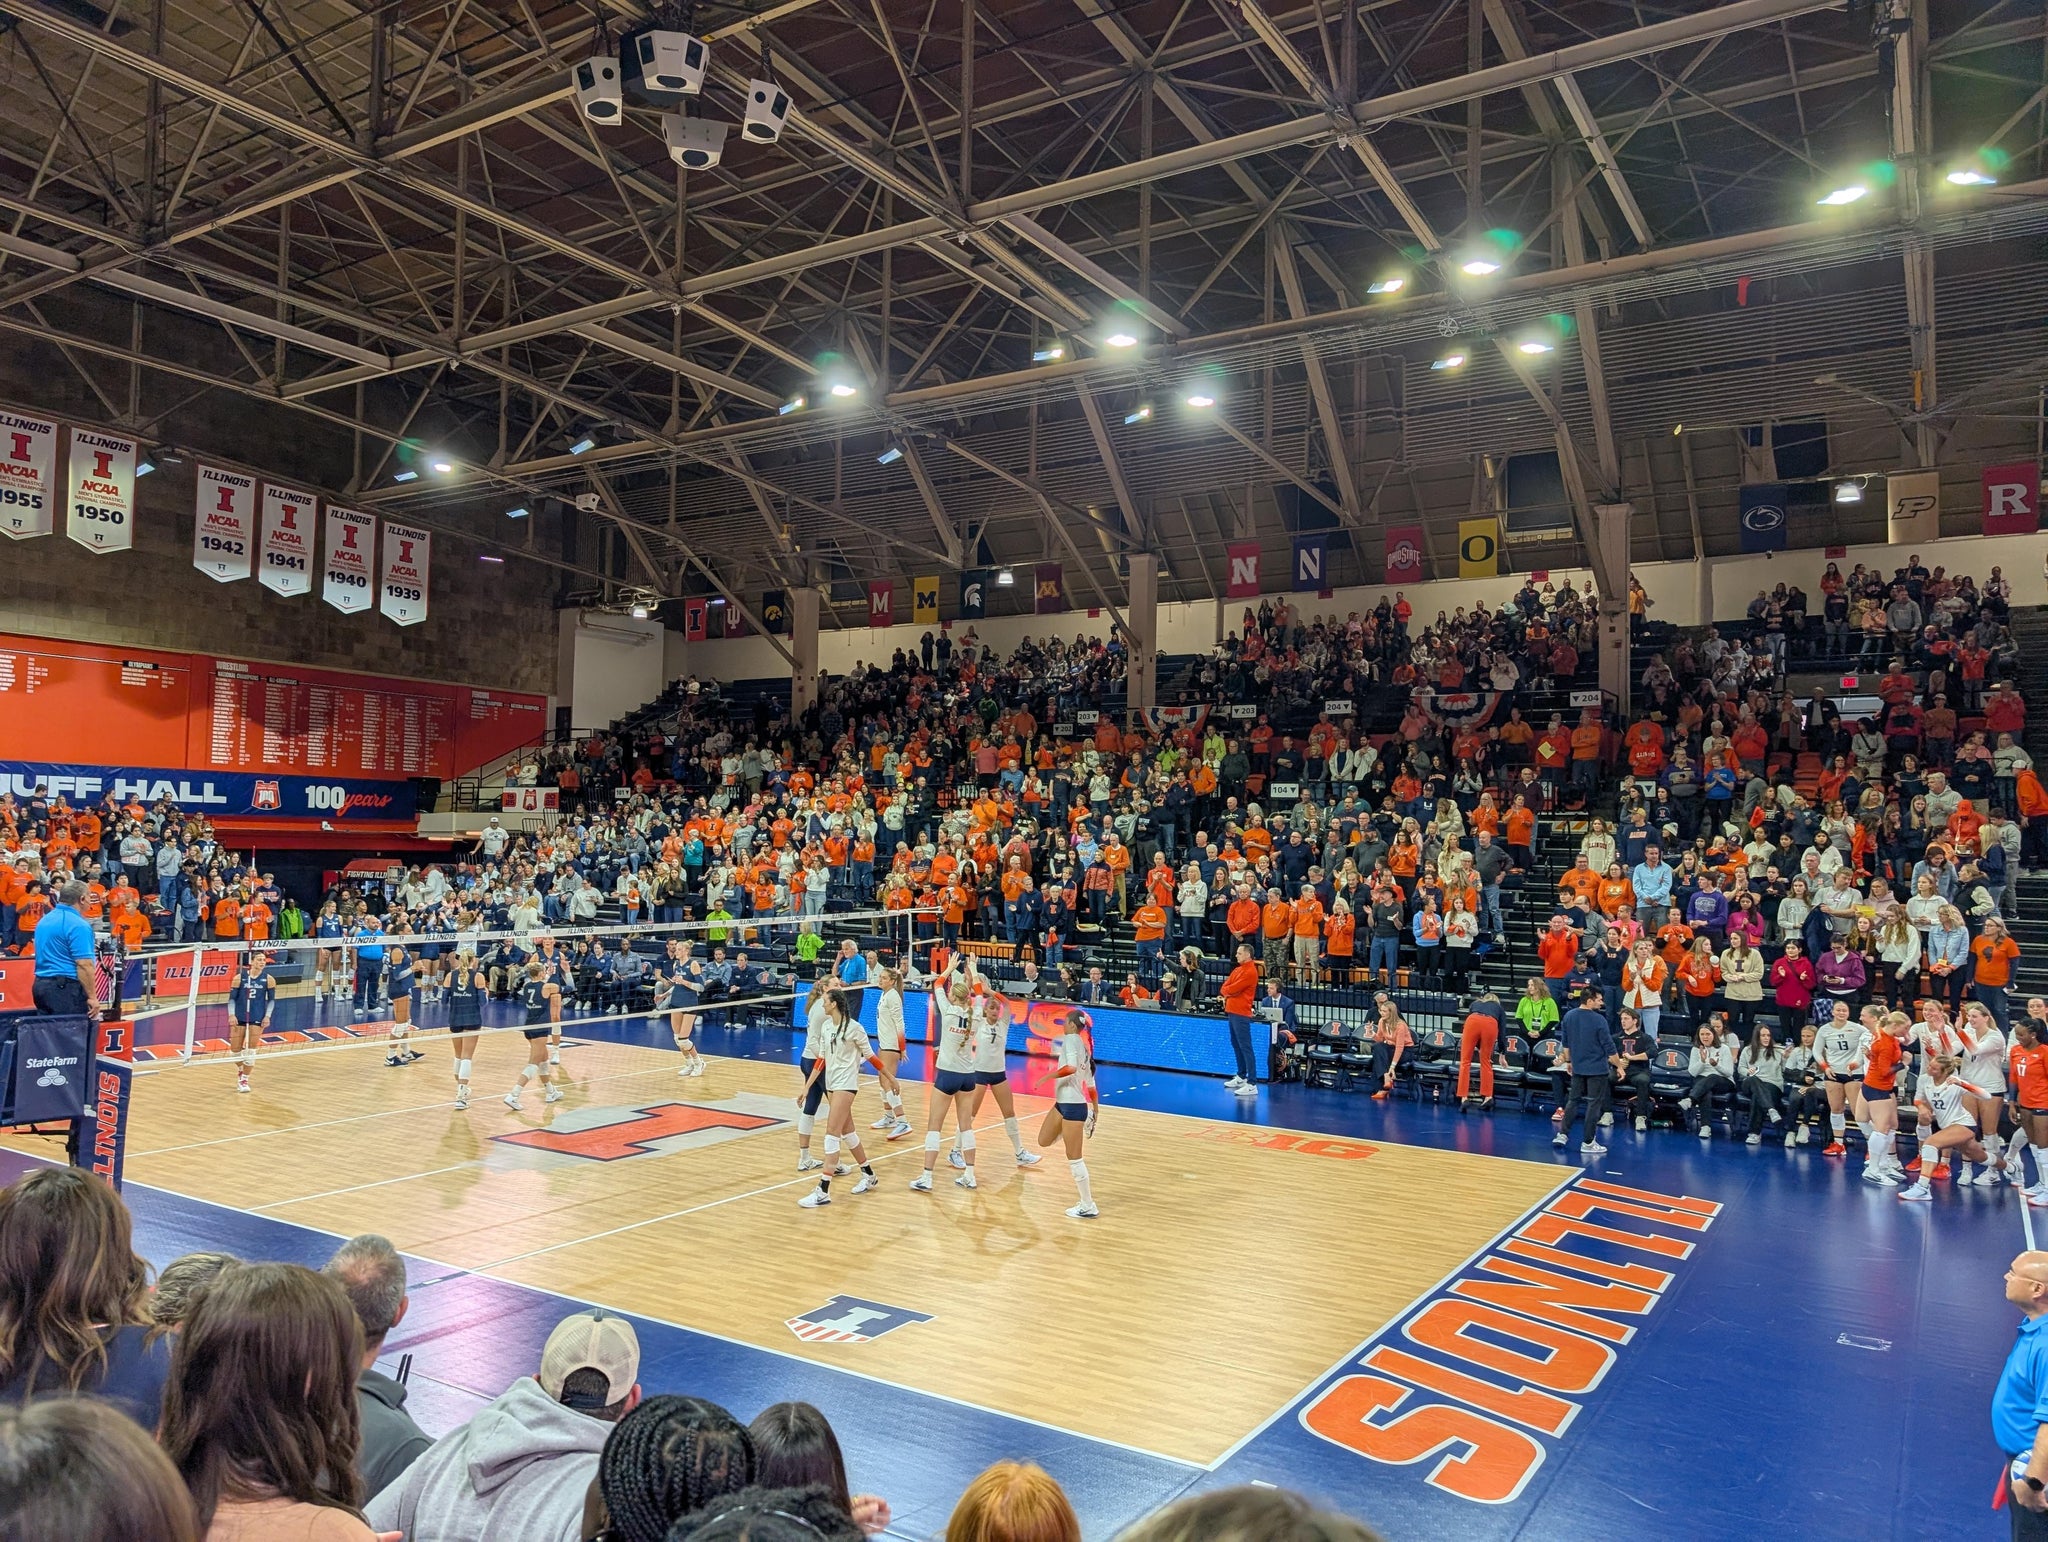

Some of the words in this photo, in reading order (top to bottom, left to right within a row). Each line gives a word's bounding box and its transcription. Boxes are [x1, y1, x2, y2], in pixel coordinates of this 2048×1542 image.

[0, 416, 51, 434] LLINOIS
[10, 432, 31, 462] I
[77, 434, 131, 452] ILLINOIS
[0, 462, 38, 480] NCAA
[93, 450, 113, 479] I
[203, 470, 250, 488] ILLINOIS
[82, 480, 118, 496] NCAA
[217, 486, 234, 512] I
[268, 489, 312, 505] ILLINOIS
[1988, 483, 2031, 516] R
[75, 504, 124, 524] 1950
[1891, 496, 1936, 520] P
[207, 514, 240, 528] NCAA
[281, 504, 297, 530] I
[331, 510, 372, 526] ILLINOIS
[272, 530, 302, 544] NCAA
[343, 524, 358, 548] I
[388, 526, 426, 540] ILLINOIS
[201, 536, 244, 555] 1942
[399, 540, 414, 563] I
[1462, 536, 1494, 562] O
[267, 552, 304, 570] 1941
[334, 550, 362, 564] NCAA
[1300, 548, 1320, 580] N
[391, 565, 417, 577] NCAA
[1232, 557, 1257, 584] N
[328, 571, 366, 588] 1940
[387, 585, 420, 600] 1939
[1036, 582, 1059, 599] M
[872, 591, 889, 614] M
[917, 591, 936, 608] M
[688, 608, 702, 632] I
[1582, 694, 1599, 702] 204
[114, 778, 227, 804] HALL
[305, 785, 345, 809] 100
[336, 793, 392, 816] years
[425, 933, 456, 941] ILLINOIS
[500, 930, 528, 938] ILLINOIS
[568, 926, 594, 934] ILLINOIS
[251, 940, 288, 948] LLINOIS
[342, 936, 377, 944] ILLINOIS
[1735, 960, 1744, 972] I
[249, 989, 256, 998] 2
[528, 989, 536, 1004] 7
[1331, 1022, 1341, 1036] I
[104, 1028, 124, 1052] I
[990, 1032, 996, 1044] 7
[1434, 1030, 1444, 1046] I
[1508, 1038, 1518, 1052] I
[1837, 1040, 1848, 1051] 13
[1546, 1042, 1556, 1056] I
[1622, 1039, 1636, 1055] I
[1666, 1052, 1678, 1066] I
[2016, 1064, 2026, 1077] 17
[1932, 1099, 1946, 1111] 22
[93, 1070, 121, 1190] LLINOIS
[489, 1103, 790, 1162] I
[1298, 1176, 1724, 1506] ILLINOIS
